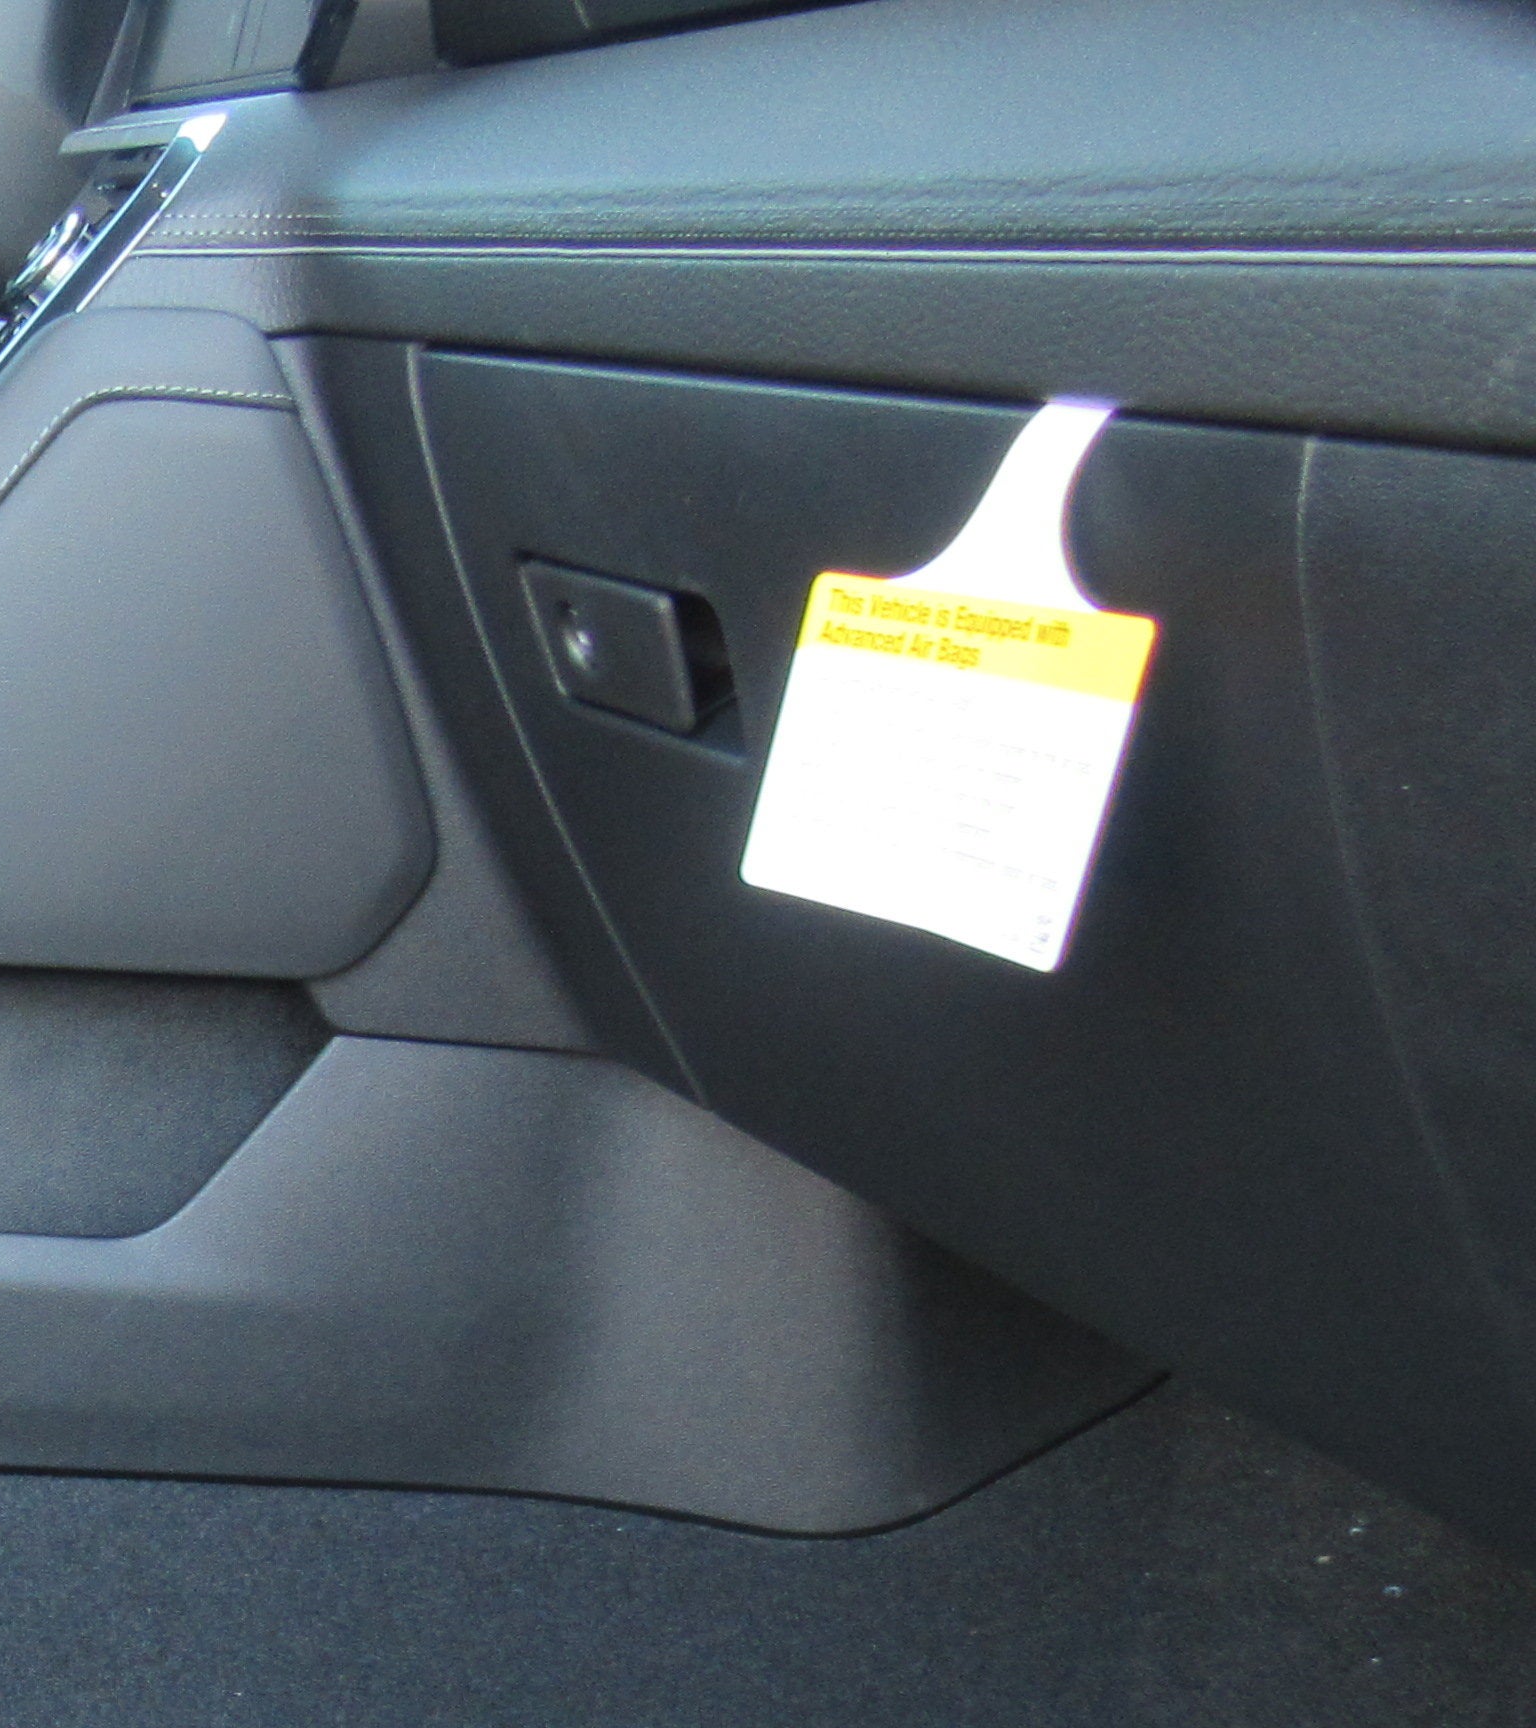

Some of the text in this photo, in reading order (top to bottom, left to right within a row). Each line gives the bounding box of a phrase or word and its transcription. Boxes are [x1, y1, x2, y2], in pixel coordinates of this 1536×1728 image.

[820, 620, 981, 671] Advanced Air Bags
[830, 587, 1071, 649] This Vehicle is Equipped with
